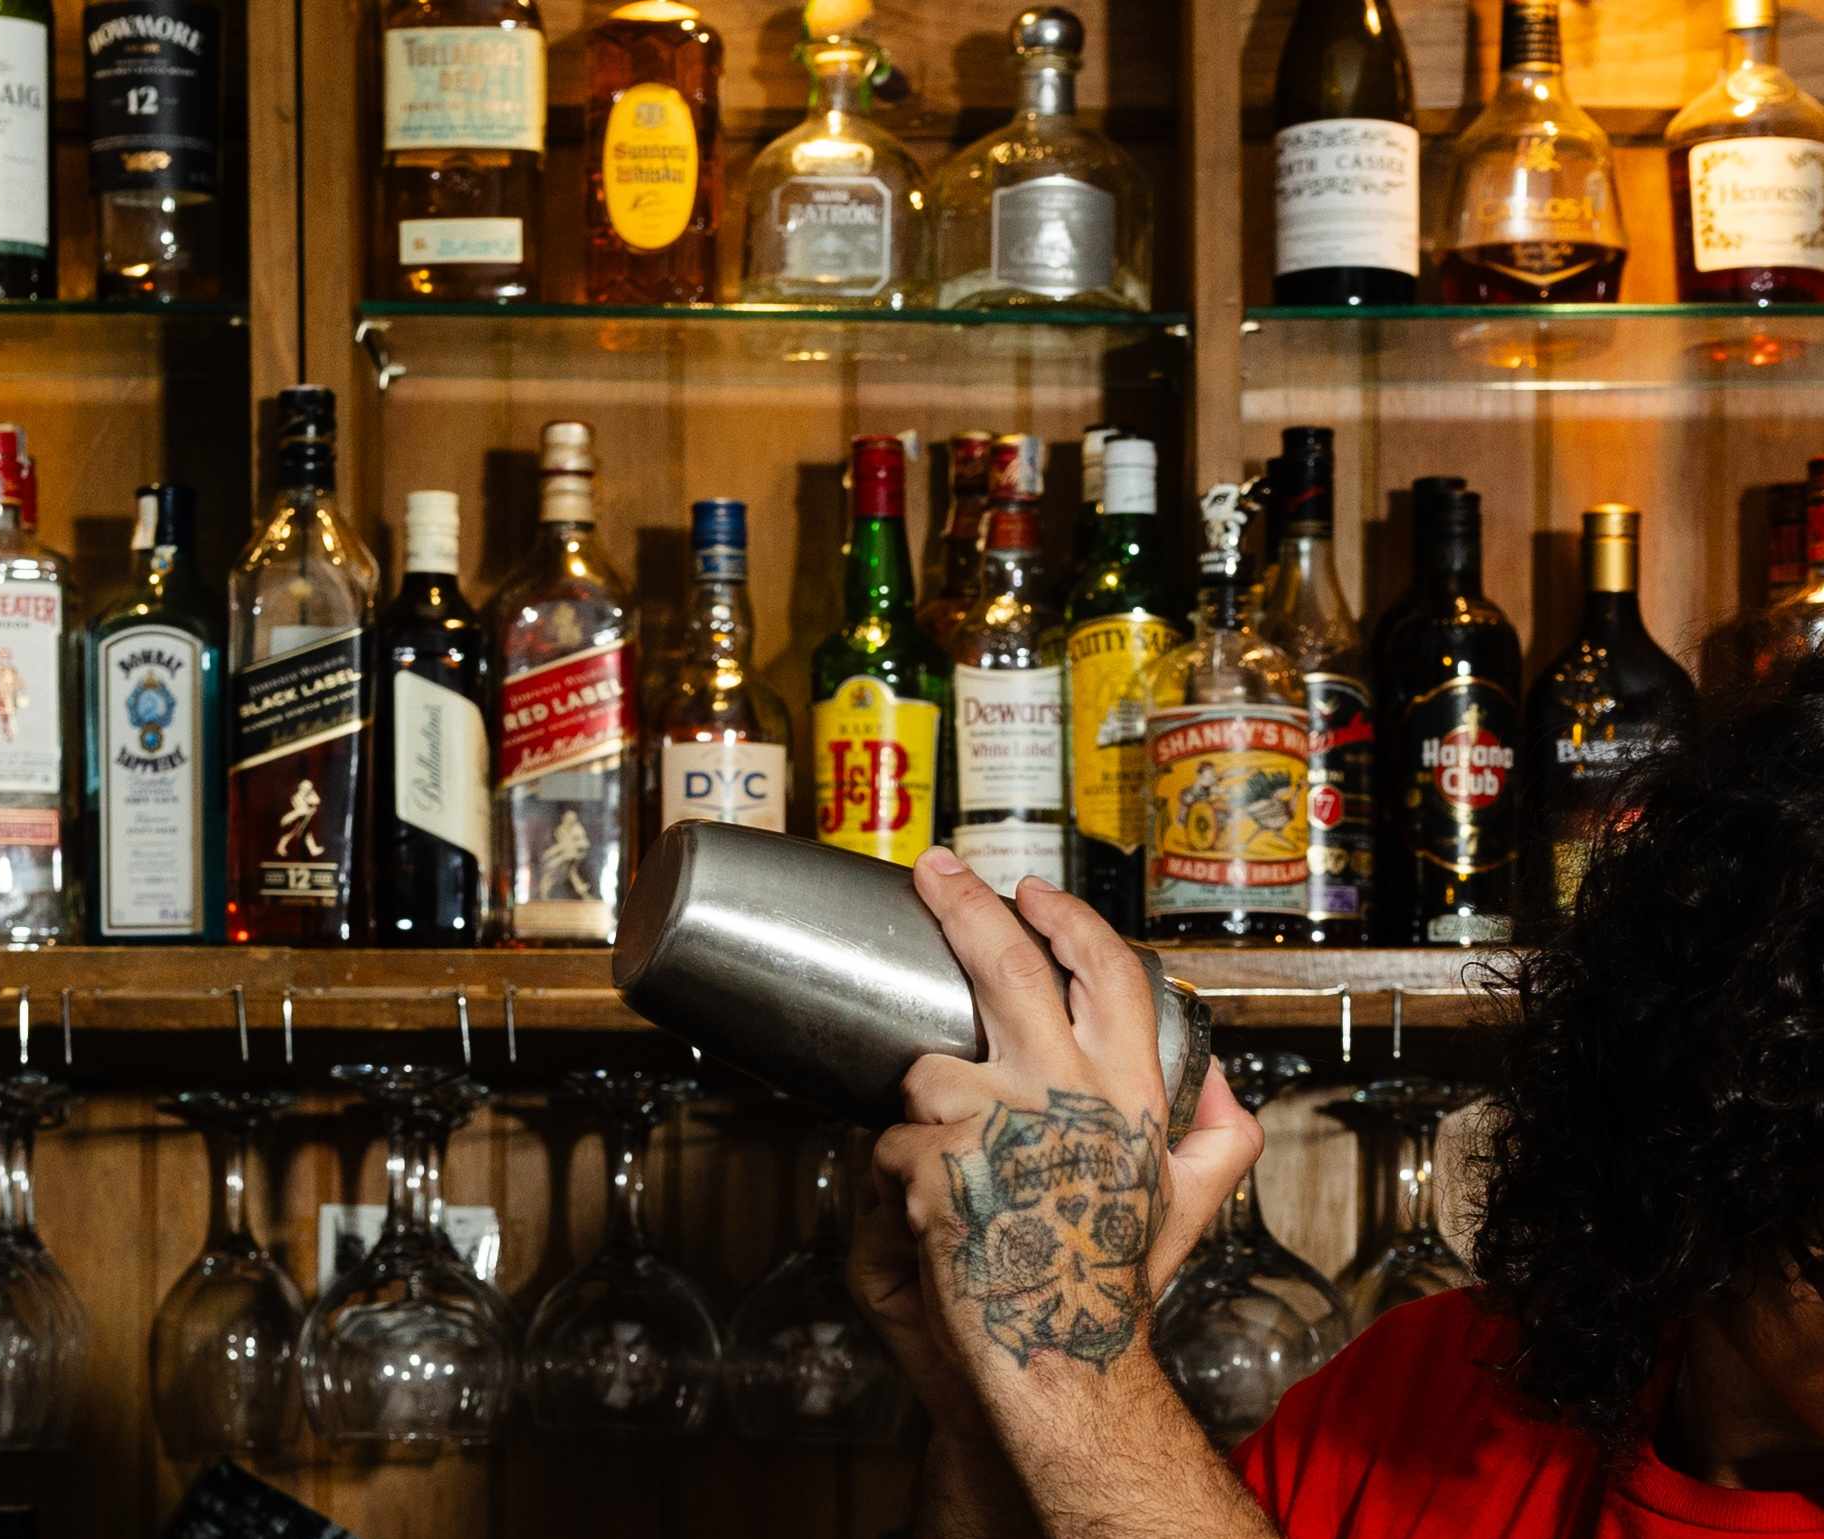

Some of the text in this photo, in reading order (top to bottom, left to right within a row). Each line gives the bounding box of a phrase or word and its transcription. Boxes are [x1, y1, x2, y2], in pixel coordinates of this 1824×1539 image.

[127, 86, 159, 115] 12
[118, 648, 185, 681] BOMBAY
[239, 669, 363, 719] BLACK LABEL
[503, 679, 625, 733] RED LABEL
[1156, 718, 1281, 763] SHANKY'S
[1423, 738, 1514, 769] Havana
[684, 770, 768, 799] DYC
[820, 740, 913, 835] J&B
[1441, 768, 1500, 796] Club
[286, 869, 311, 889] 12
